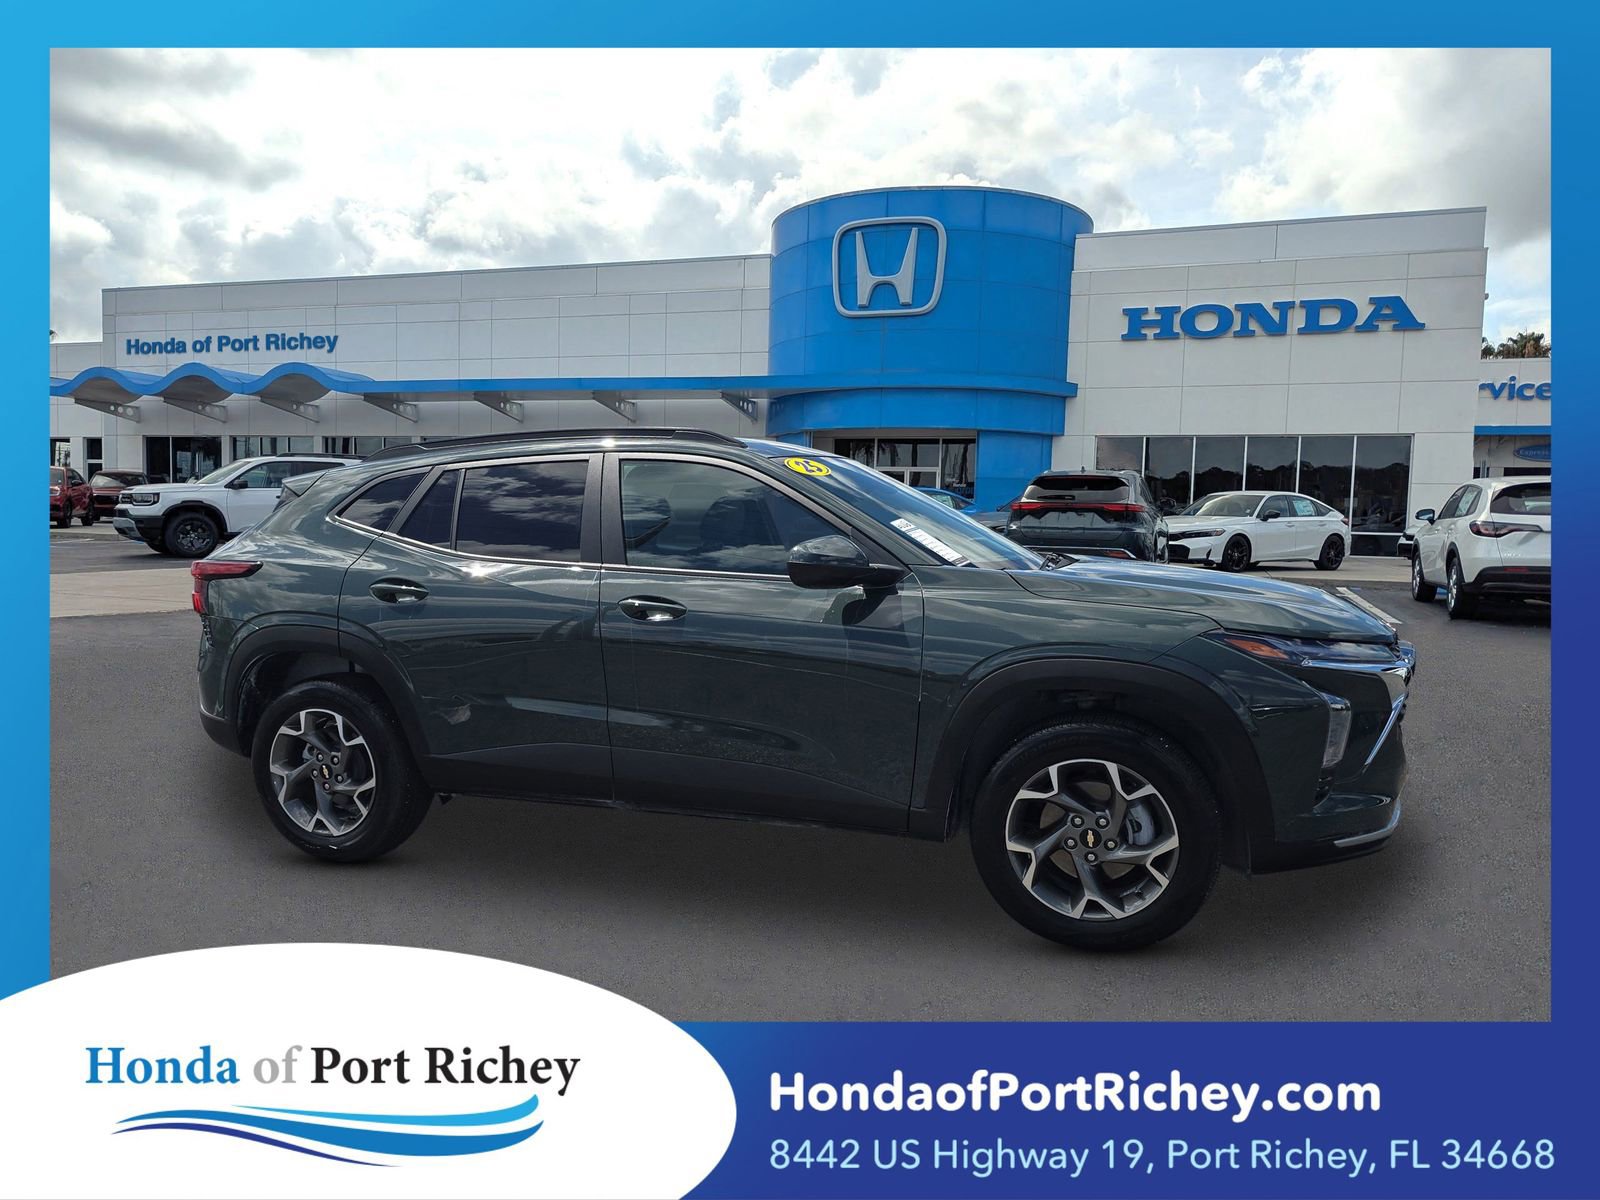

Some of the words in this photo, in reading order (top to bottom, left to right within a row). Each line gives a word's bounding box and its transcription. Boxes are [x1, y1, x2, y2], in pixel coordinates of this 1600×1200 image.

[1120, 296, 1425, 340] HONDA
[126, 337, 187, 355] Honda
[192, 335, 212, 353] of
[218, 335, 259, 353] Port
[265, 332, 338, 353] Richey
[794, 459, 823, 473] 25
